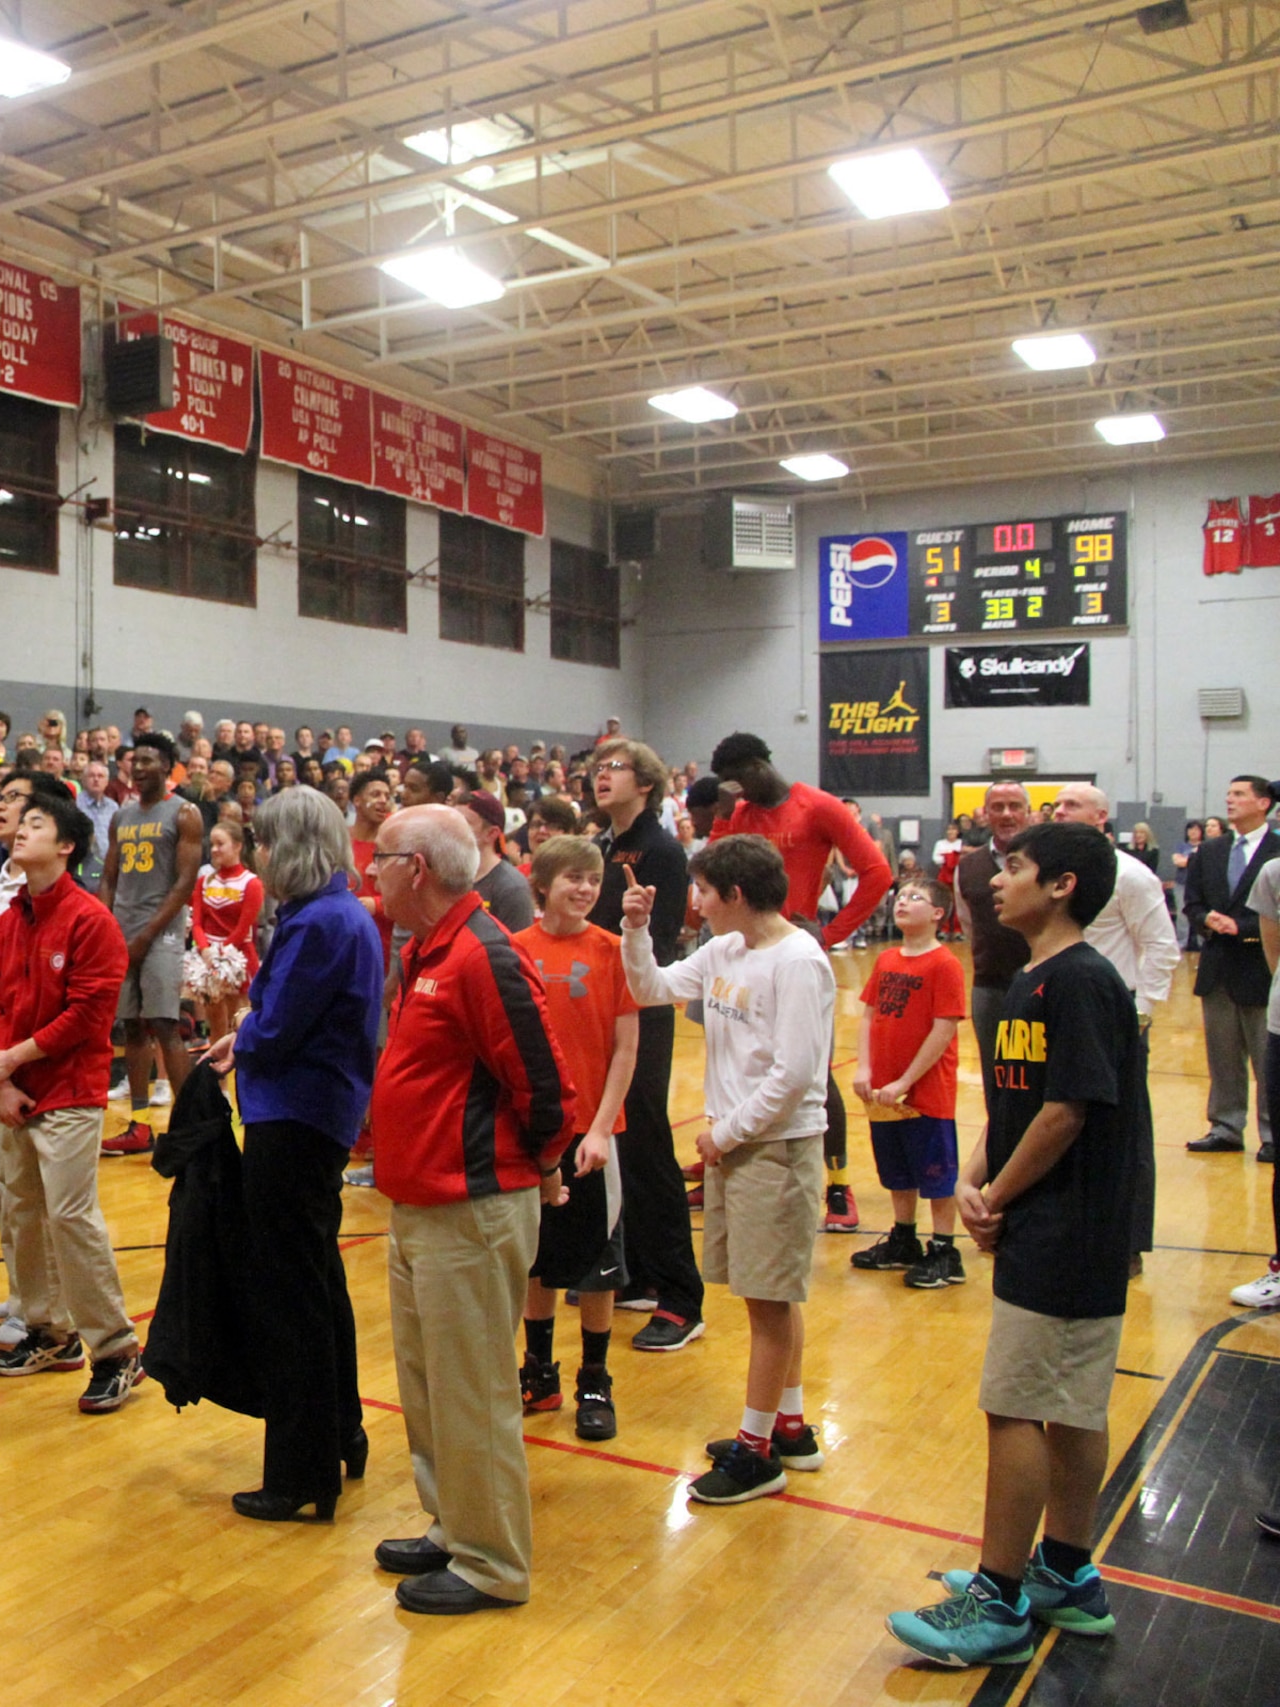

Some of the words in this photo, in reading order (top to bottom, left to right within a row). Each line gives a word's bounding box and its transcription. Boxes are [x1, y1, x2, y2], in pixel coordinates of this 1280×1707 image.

[186, 374, 222, 399] TODAY
[230, 363, 245, 387] UP
[186, 394, 217, 419] POLL
[180, 413, 206, 434] 40-1
[1067, 516, 1116, 533] HOME
[1212, 529, 1235, 543] 12
[916, 530, 964, 545] GUEST
[993, 522, 1035, 553] 0.0
[1075, 533, 1113, 564] 98
[926, 546, 961, 575] 51
[973, 565, 1020, 578] PERIOD
[1024, 557, 1041, 579] 4
[829, 543, 853, 628] PEPSI
[936, 601, 951, 623] 3
[985, 597, 1014, 620] 33
[1027, 596, 1043, 618] 2
[1086, 592, 1102, 615] 3
[980, 650, 1083, 677] Skullcandy
[829, 701, 881, 719] THIS
[840, 715, 921, 735] FLIGHT
[139, 822, 163, 838] HILL
[121, 841, 155, 873] 33
